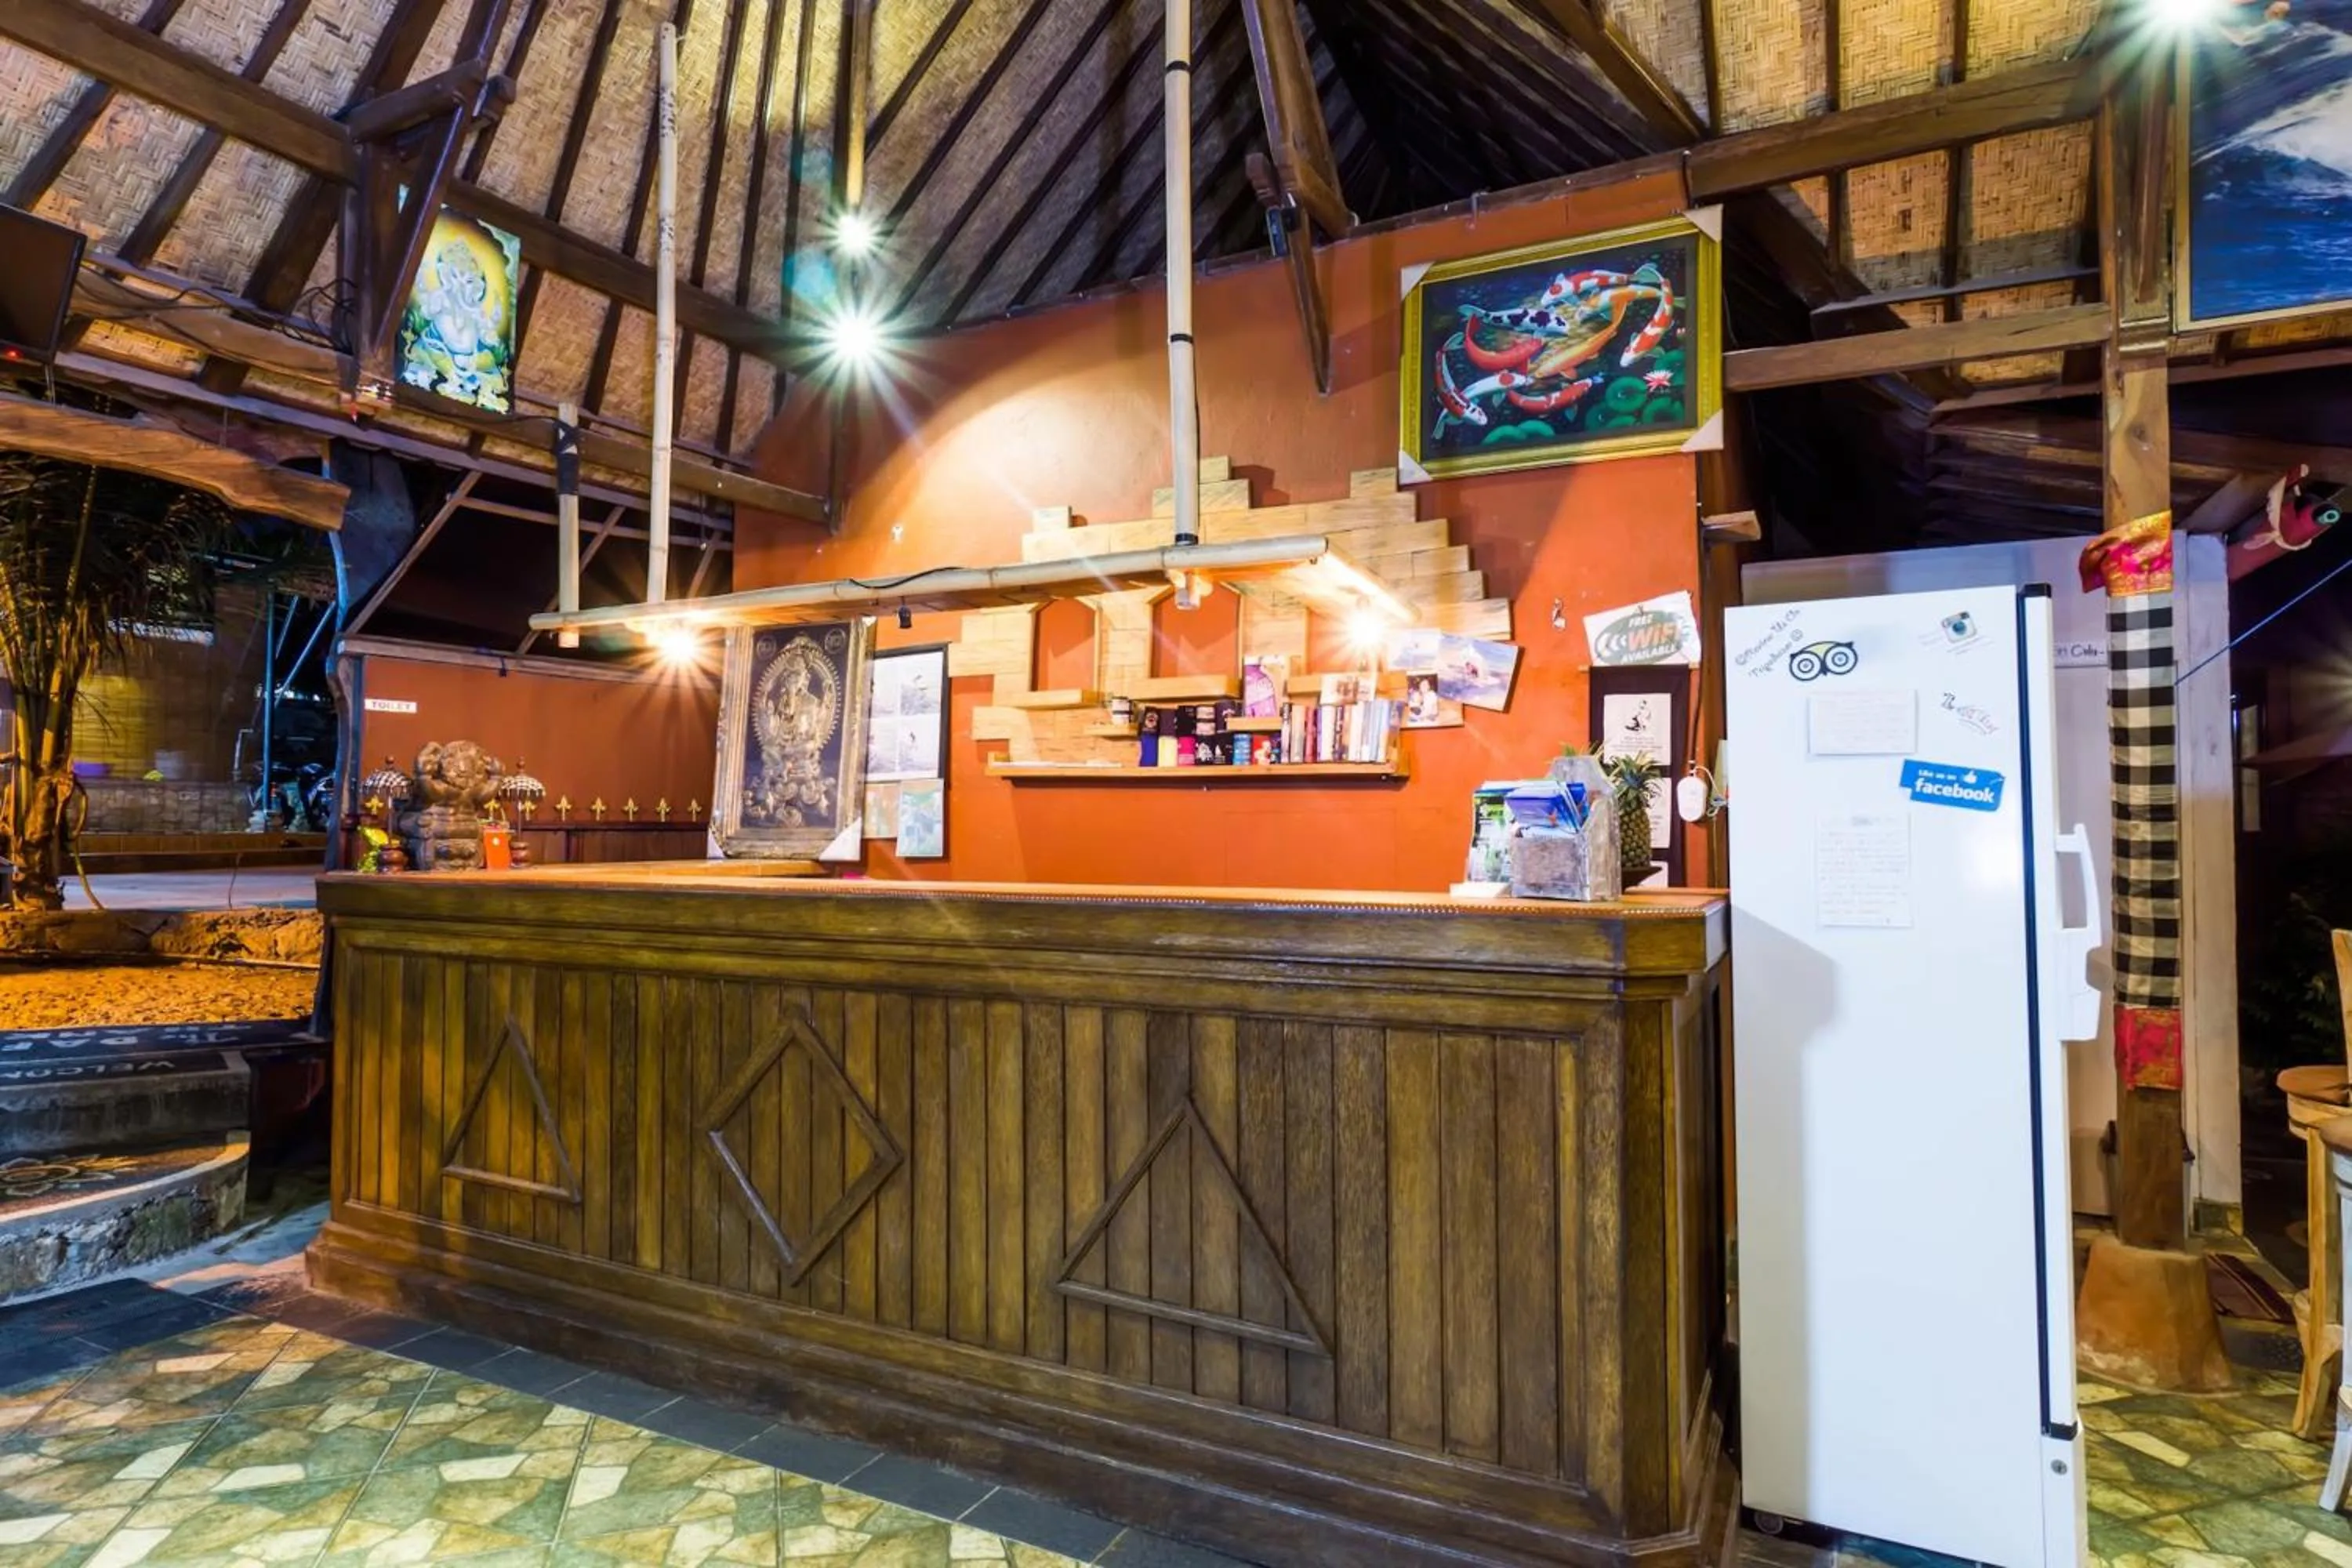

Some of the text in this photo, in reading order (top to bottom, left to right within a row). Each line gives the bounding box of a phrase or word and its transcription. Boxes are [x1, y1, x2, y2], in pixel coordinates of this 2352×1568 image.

[1628, 614, 1653, 627] FREE
[372, 701, 412, 710] TOILET
[1915, 778, 1994, 803] facebook
